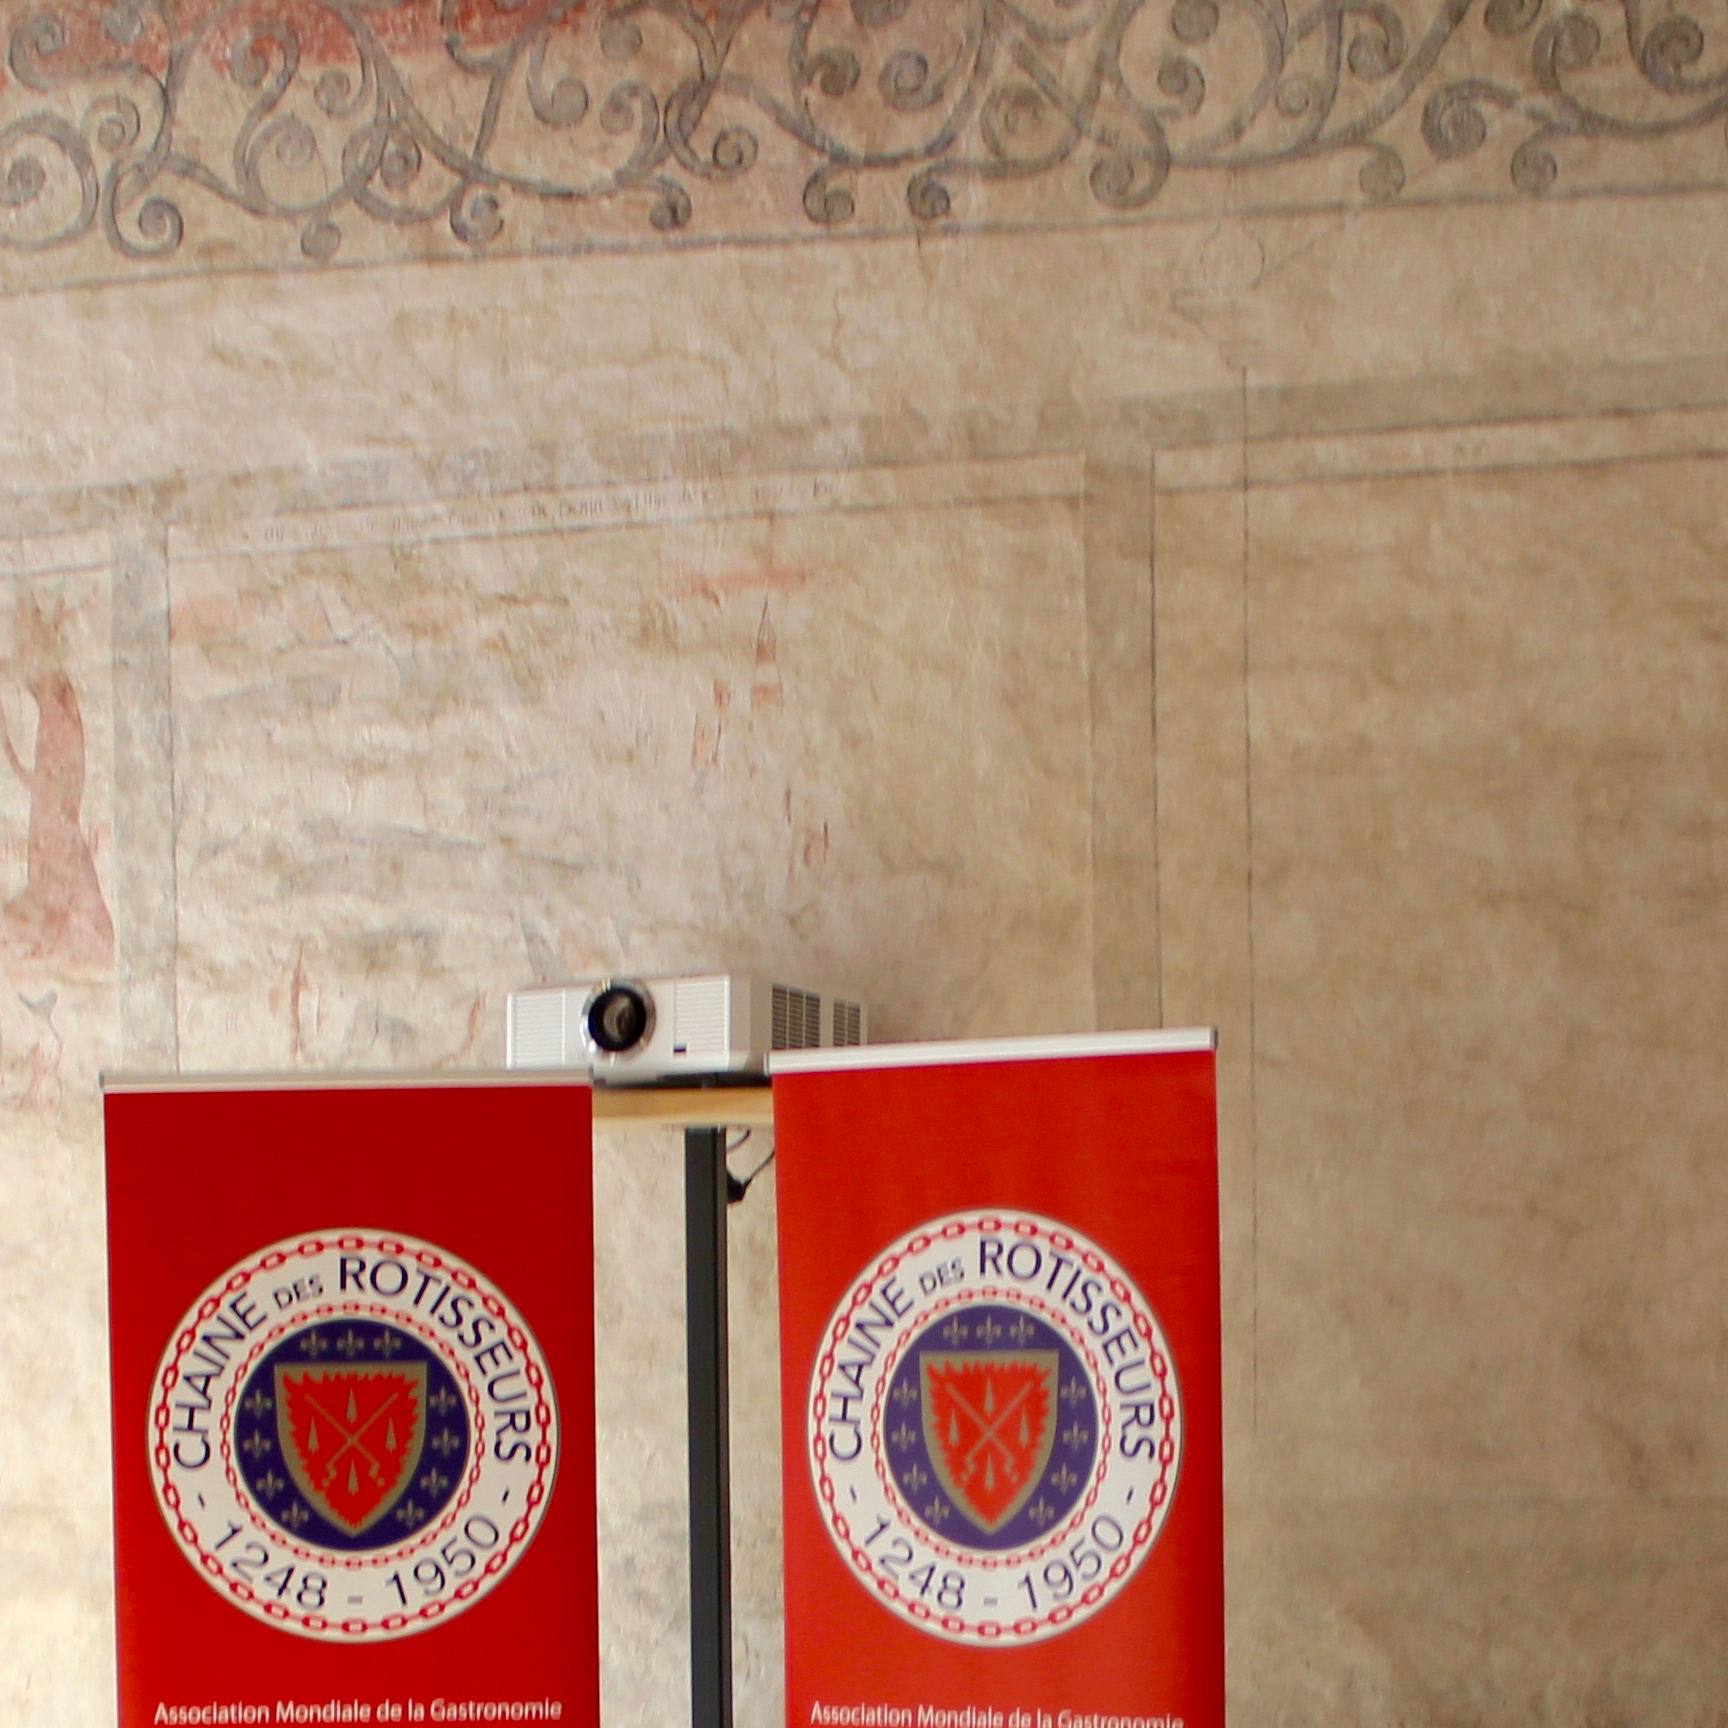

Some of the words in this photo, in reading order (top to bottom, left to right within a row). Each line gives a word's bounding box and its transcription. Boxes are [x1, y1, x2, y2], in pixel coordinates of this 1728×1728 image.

[173, 1291, 267, 1470] CHAINE
[272, 1275, 324, 1310] DES
[339, 1255, 533, 1465] ROTISSEURS
[828, 1275, 915, 1462] CHAINE
[918, 1257, 966, 1296] DES
[978, 1236, 1157, 1464] ROTISSEURS
[213, 1521, 328, 1611] 1248
[385, 1514, 500, 1609] 1950
[862, 1515, 967, 1613] 1248
[1017, 1513, 1126, 1612] 1950
[153, 1700, 271, 1726] Association
[275, 1698, 372, 1725] Mondiale
[376, 1698, 403, 1723] de
[407, 1698, 425, 1723] la
[429, 1696, 563, 1722] Gastronomie
[809, 1699, 913, 1728] Association
